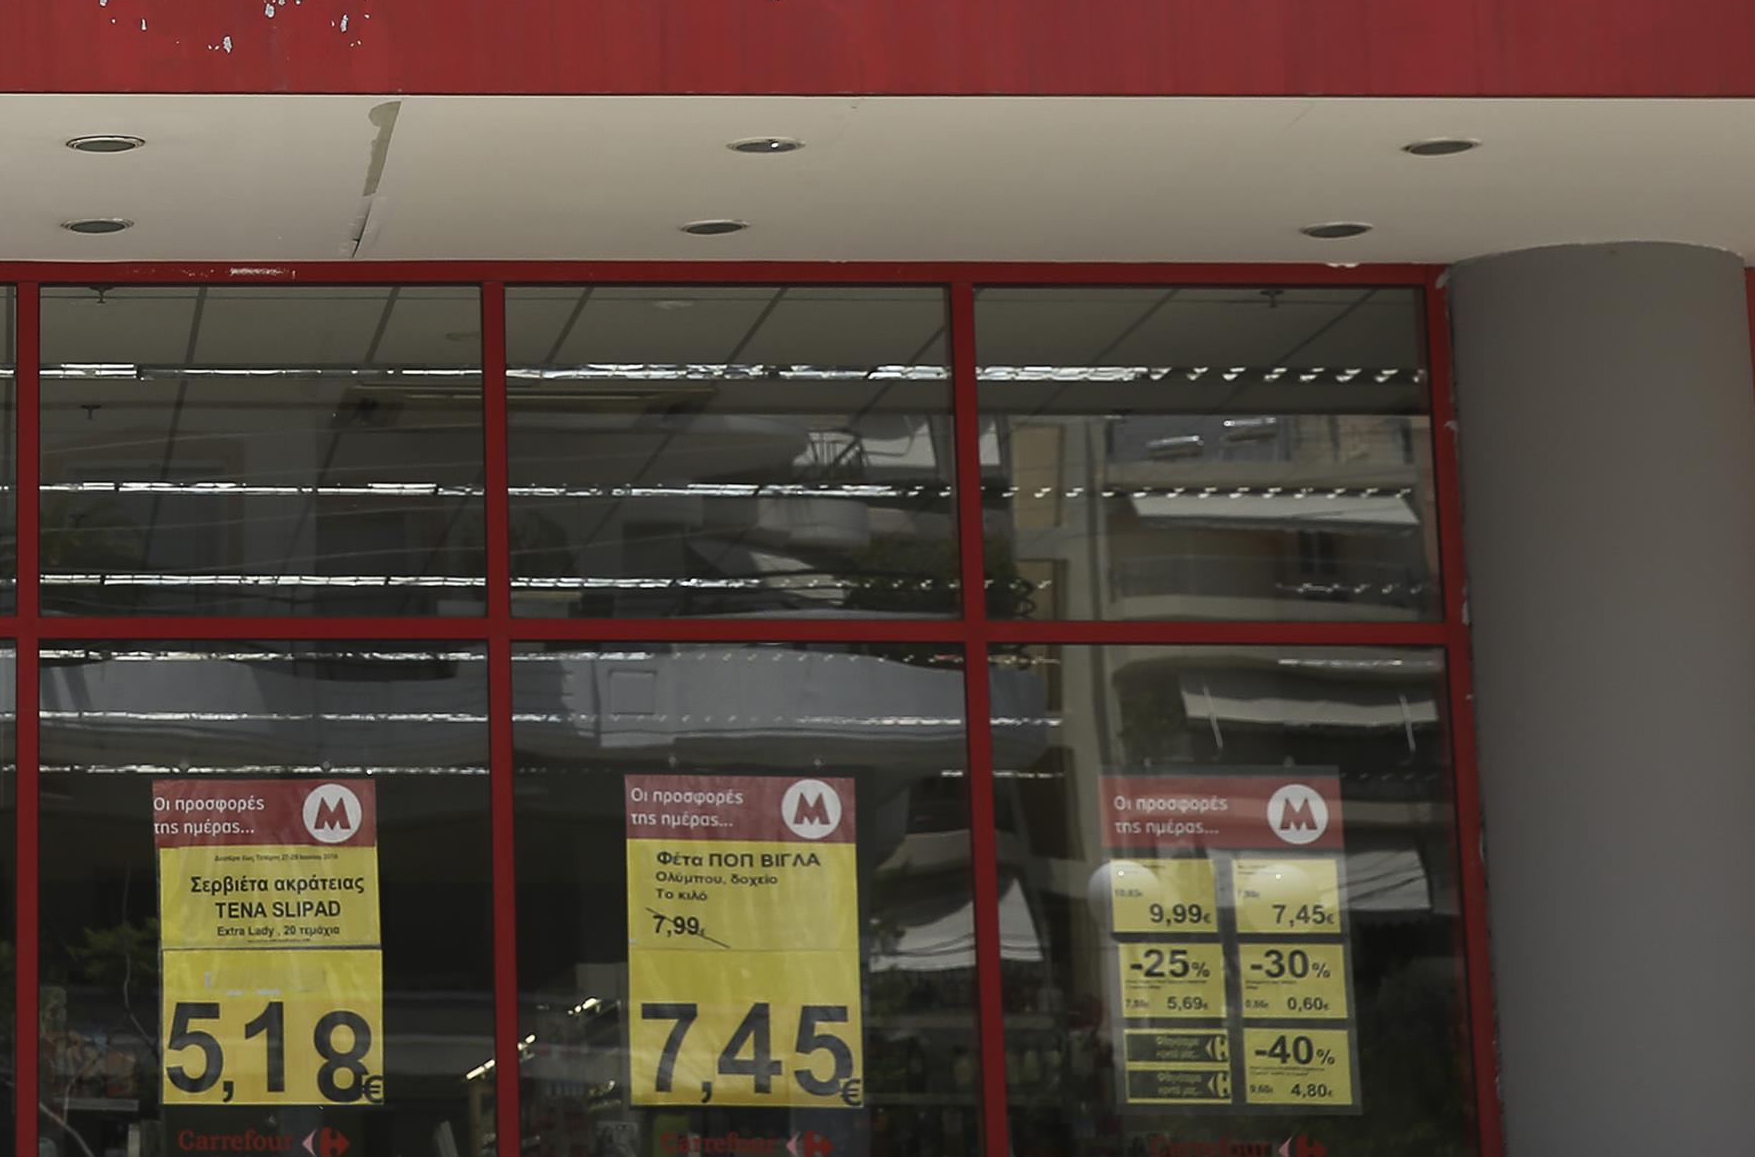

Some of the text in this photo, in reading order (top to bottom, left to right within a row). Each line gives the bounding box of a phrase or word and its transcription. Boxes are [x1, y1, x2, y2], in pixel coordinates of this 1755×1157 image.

[153, 797, 265, 814] Οι προσφορές
[631, 788, 743, 807] Οι προσφορές
[1114, 796, 1228, 815] Οι προσφορές
[154, 820, 255, 837] της ημέρας...
[631, 811, 733, 829] της ημέρας...
[1114, 819, 1219, 836] της ημέρας...
[657, 851, 820, 868] Φέτα ΠΟΠ ΒΙΓΛΑ
[191, 875, 364, 897] Σερβιέτα ακράτειας
[656, 871, 778, 887] Ολύμπου, δοχείο
[656, 889, 708, 901] Το κιλό
[216, 900, 341, 918] TENA SLIPAD
[1149, 903, 1211, 927] 9,99€
[1272, 904, 1335, 928] 7,45€
[217, 925, 340, 939] Extra Lady 20 τεμάχια
[1130, 948, 1210, 978] -25%
[1250, 949, 1331, 979] -30%
[1255, 1035, 1335, 1065] -40%
[178, 1128, 294, 1151] Carrefour
